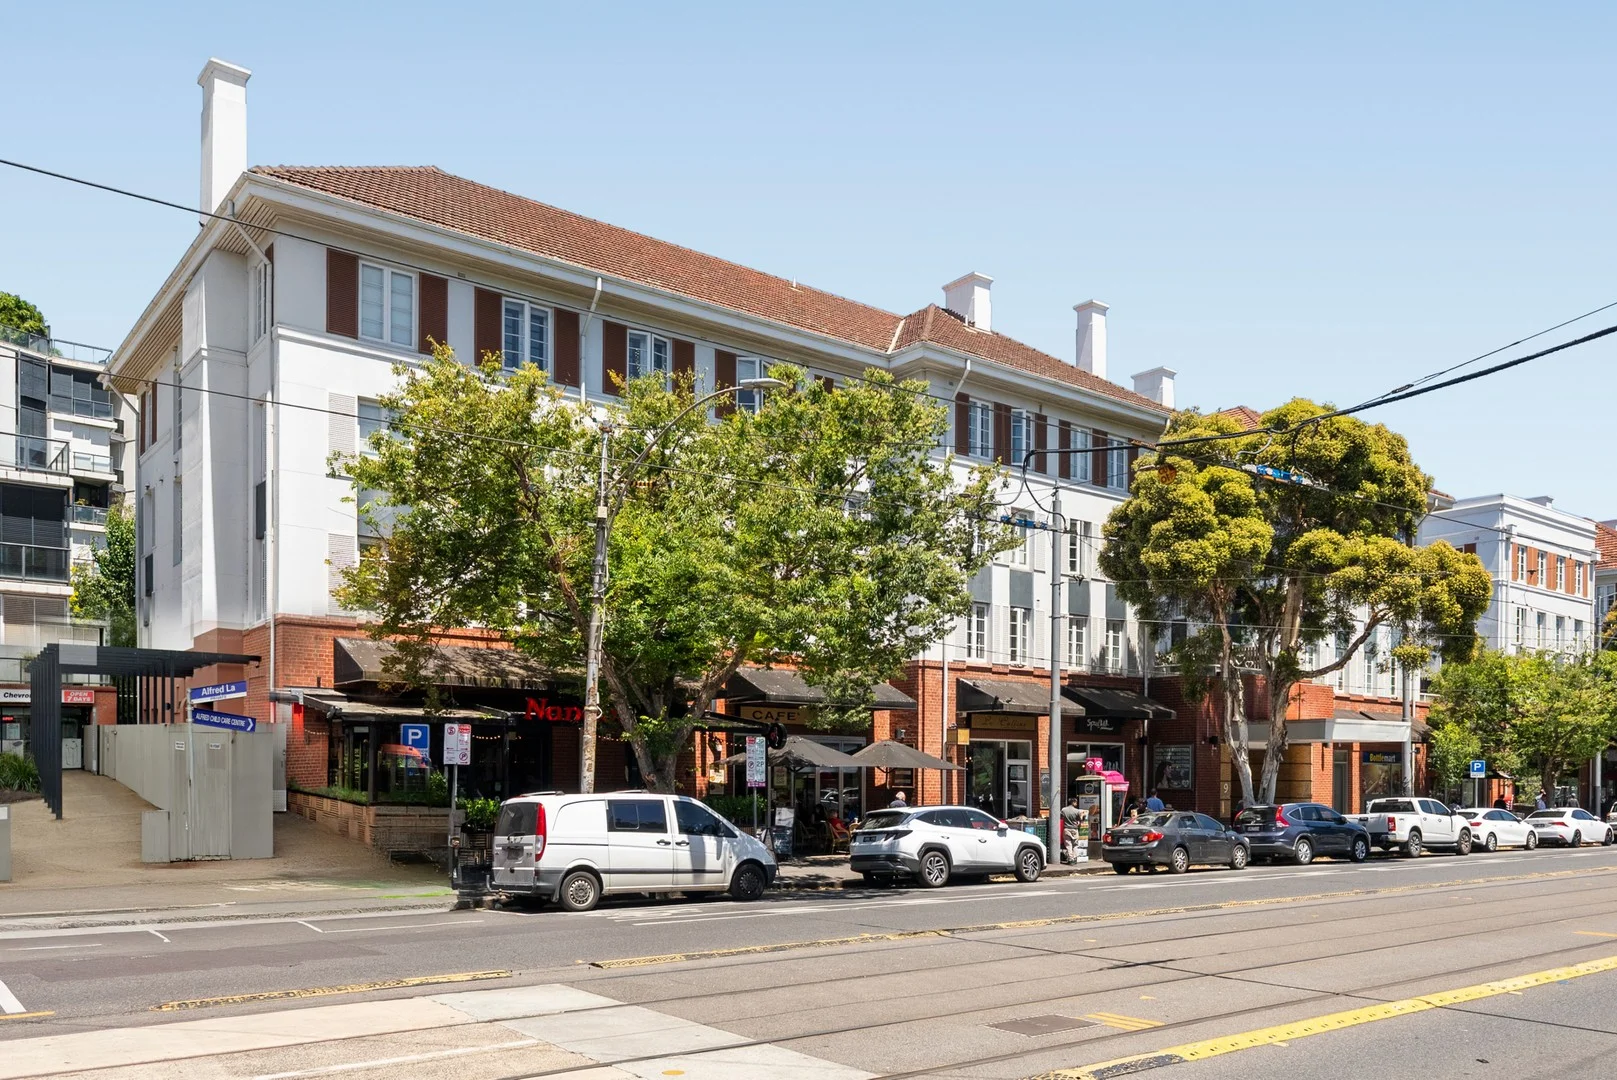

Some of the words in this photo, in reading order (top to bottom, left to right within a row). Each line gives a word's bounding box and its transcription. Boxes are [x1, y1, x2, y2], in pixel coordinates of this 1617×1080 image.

[201, 685, 224, 696] Alfred
[225, 683, 236, 692] La
[209, 715, 221, 723] CHILD
[220, 717, 231, 725] CARE
[230, 719, 246, 727] CENTRE
[408, 728, 422, 745] P
[1369, 753, 1396, 762] Bottlemart
[1474, 763, 1482, 771] P
[1223, 783, 1229, 793] 9
